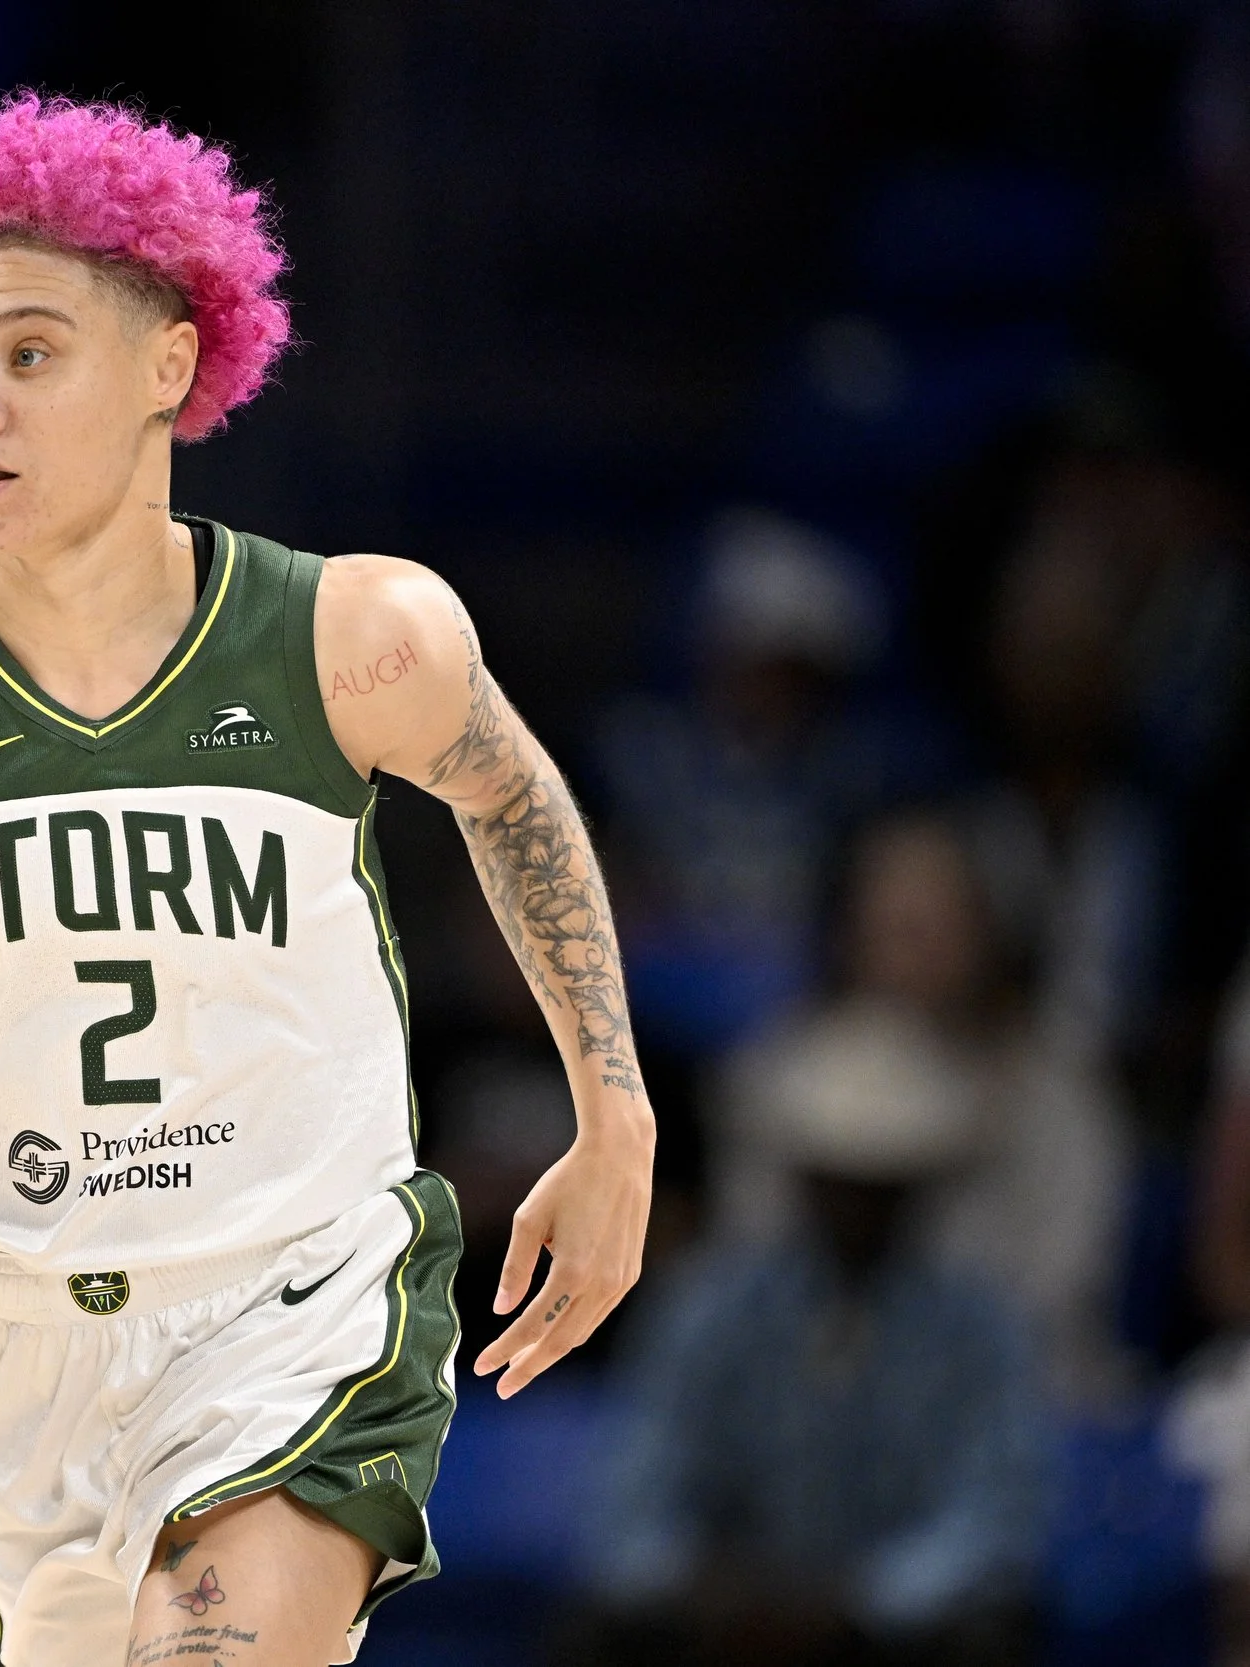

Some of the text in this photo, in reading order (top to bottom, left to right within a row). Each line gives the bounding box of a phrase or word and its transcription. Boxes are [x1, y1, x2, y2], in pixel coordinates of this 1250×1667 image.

[321, 640, 419, 702] AUGH
[189, 730, 275, 748] SYMETRA
[74, 960, 162, 1106] 2
[80, 1121, 236, 1161] Providence
[78, 1162, 192, 1198] SWEDISH
[216, 1624, 259, 1643] friend
